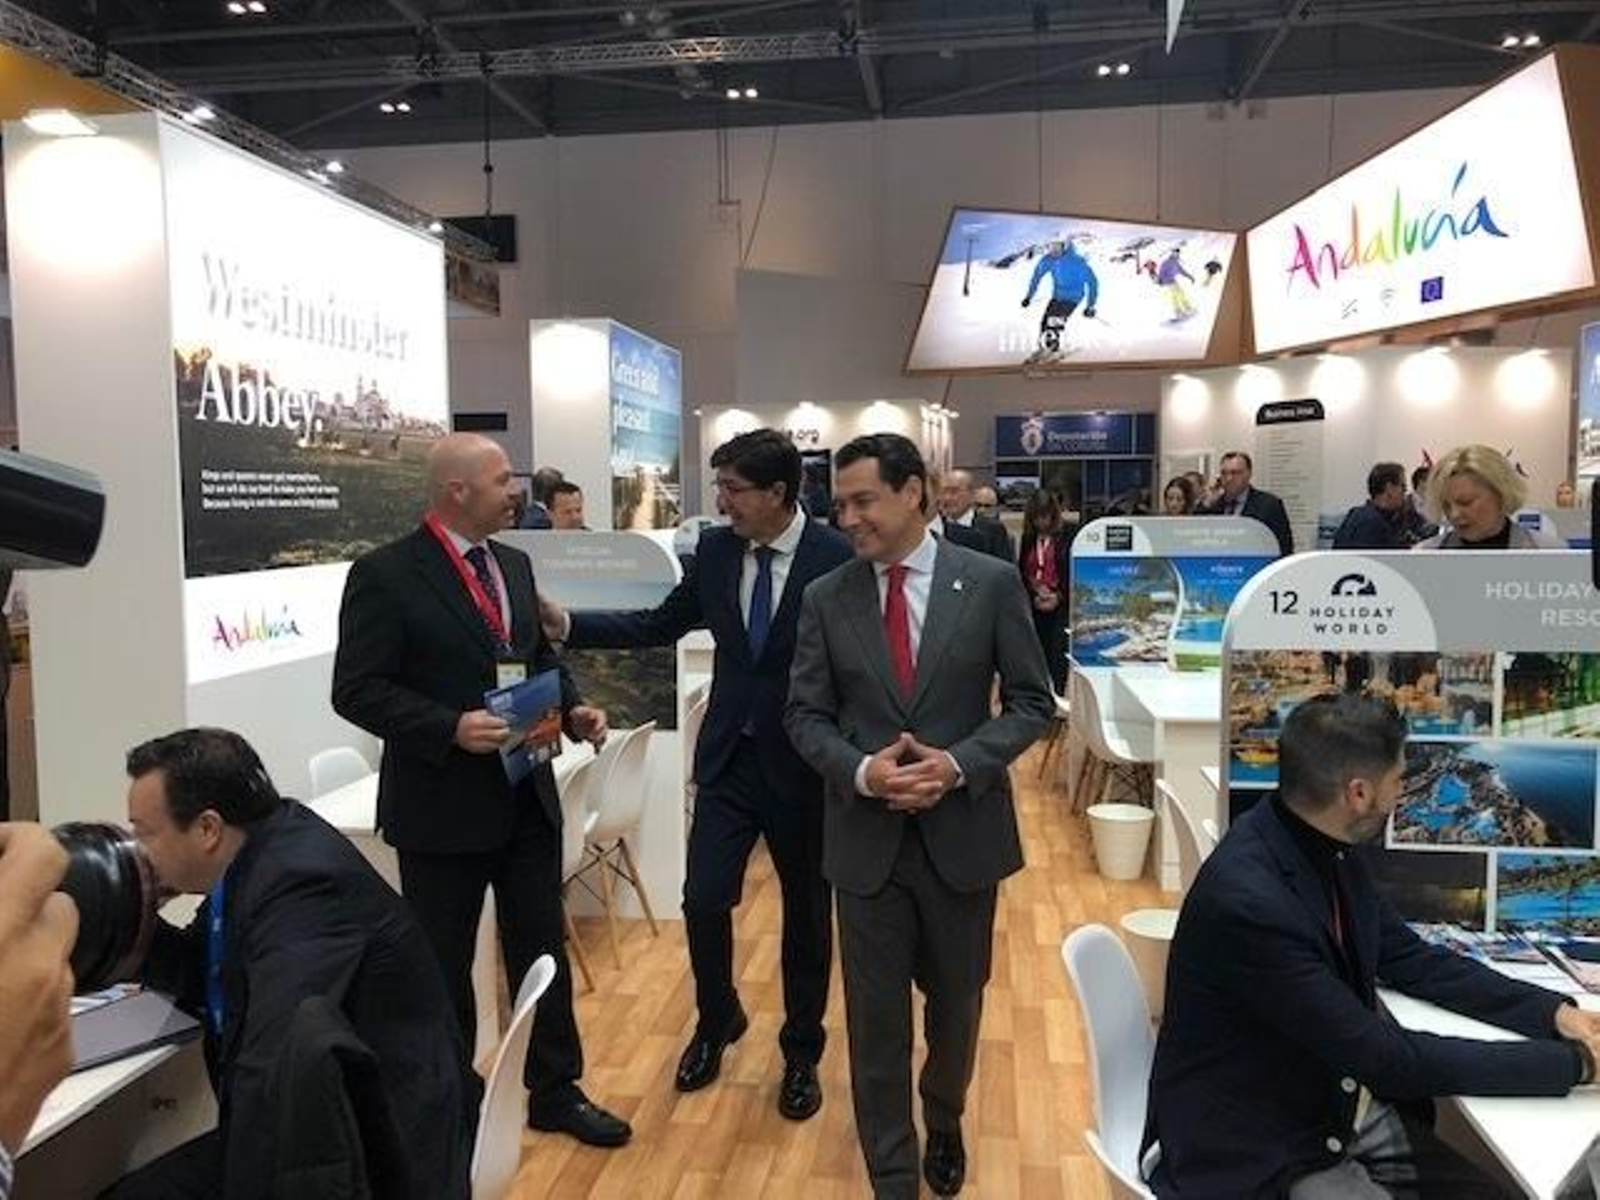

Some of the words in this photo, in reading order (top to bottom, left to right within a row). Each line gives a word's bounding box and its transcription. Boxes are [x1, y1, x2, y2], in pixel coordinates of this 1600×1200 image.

[1285, 160, 1510, 297] Andalucía
[201, 252, 410, 362] Westminster
[195, 362, 324, 444] Abbey.
[1269, 591, 1298, 615] 12
[1485, 582, 1594, 600] HOLIDAY
[1309, 606, 1394, 618] HOLIDAY
[1313, 623, 1388, 635] WORLD
